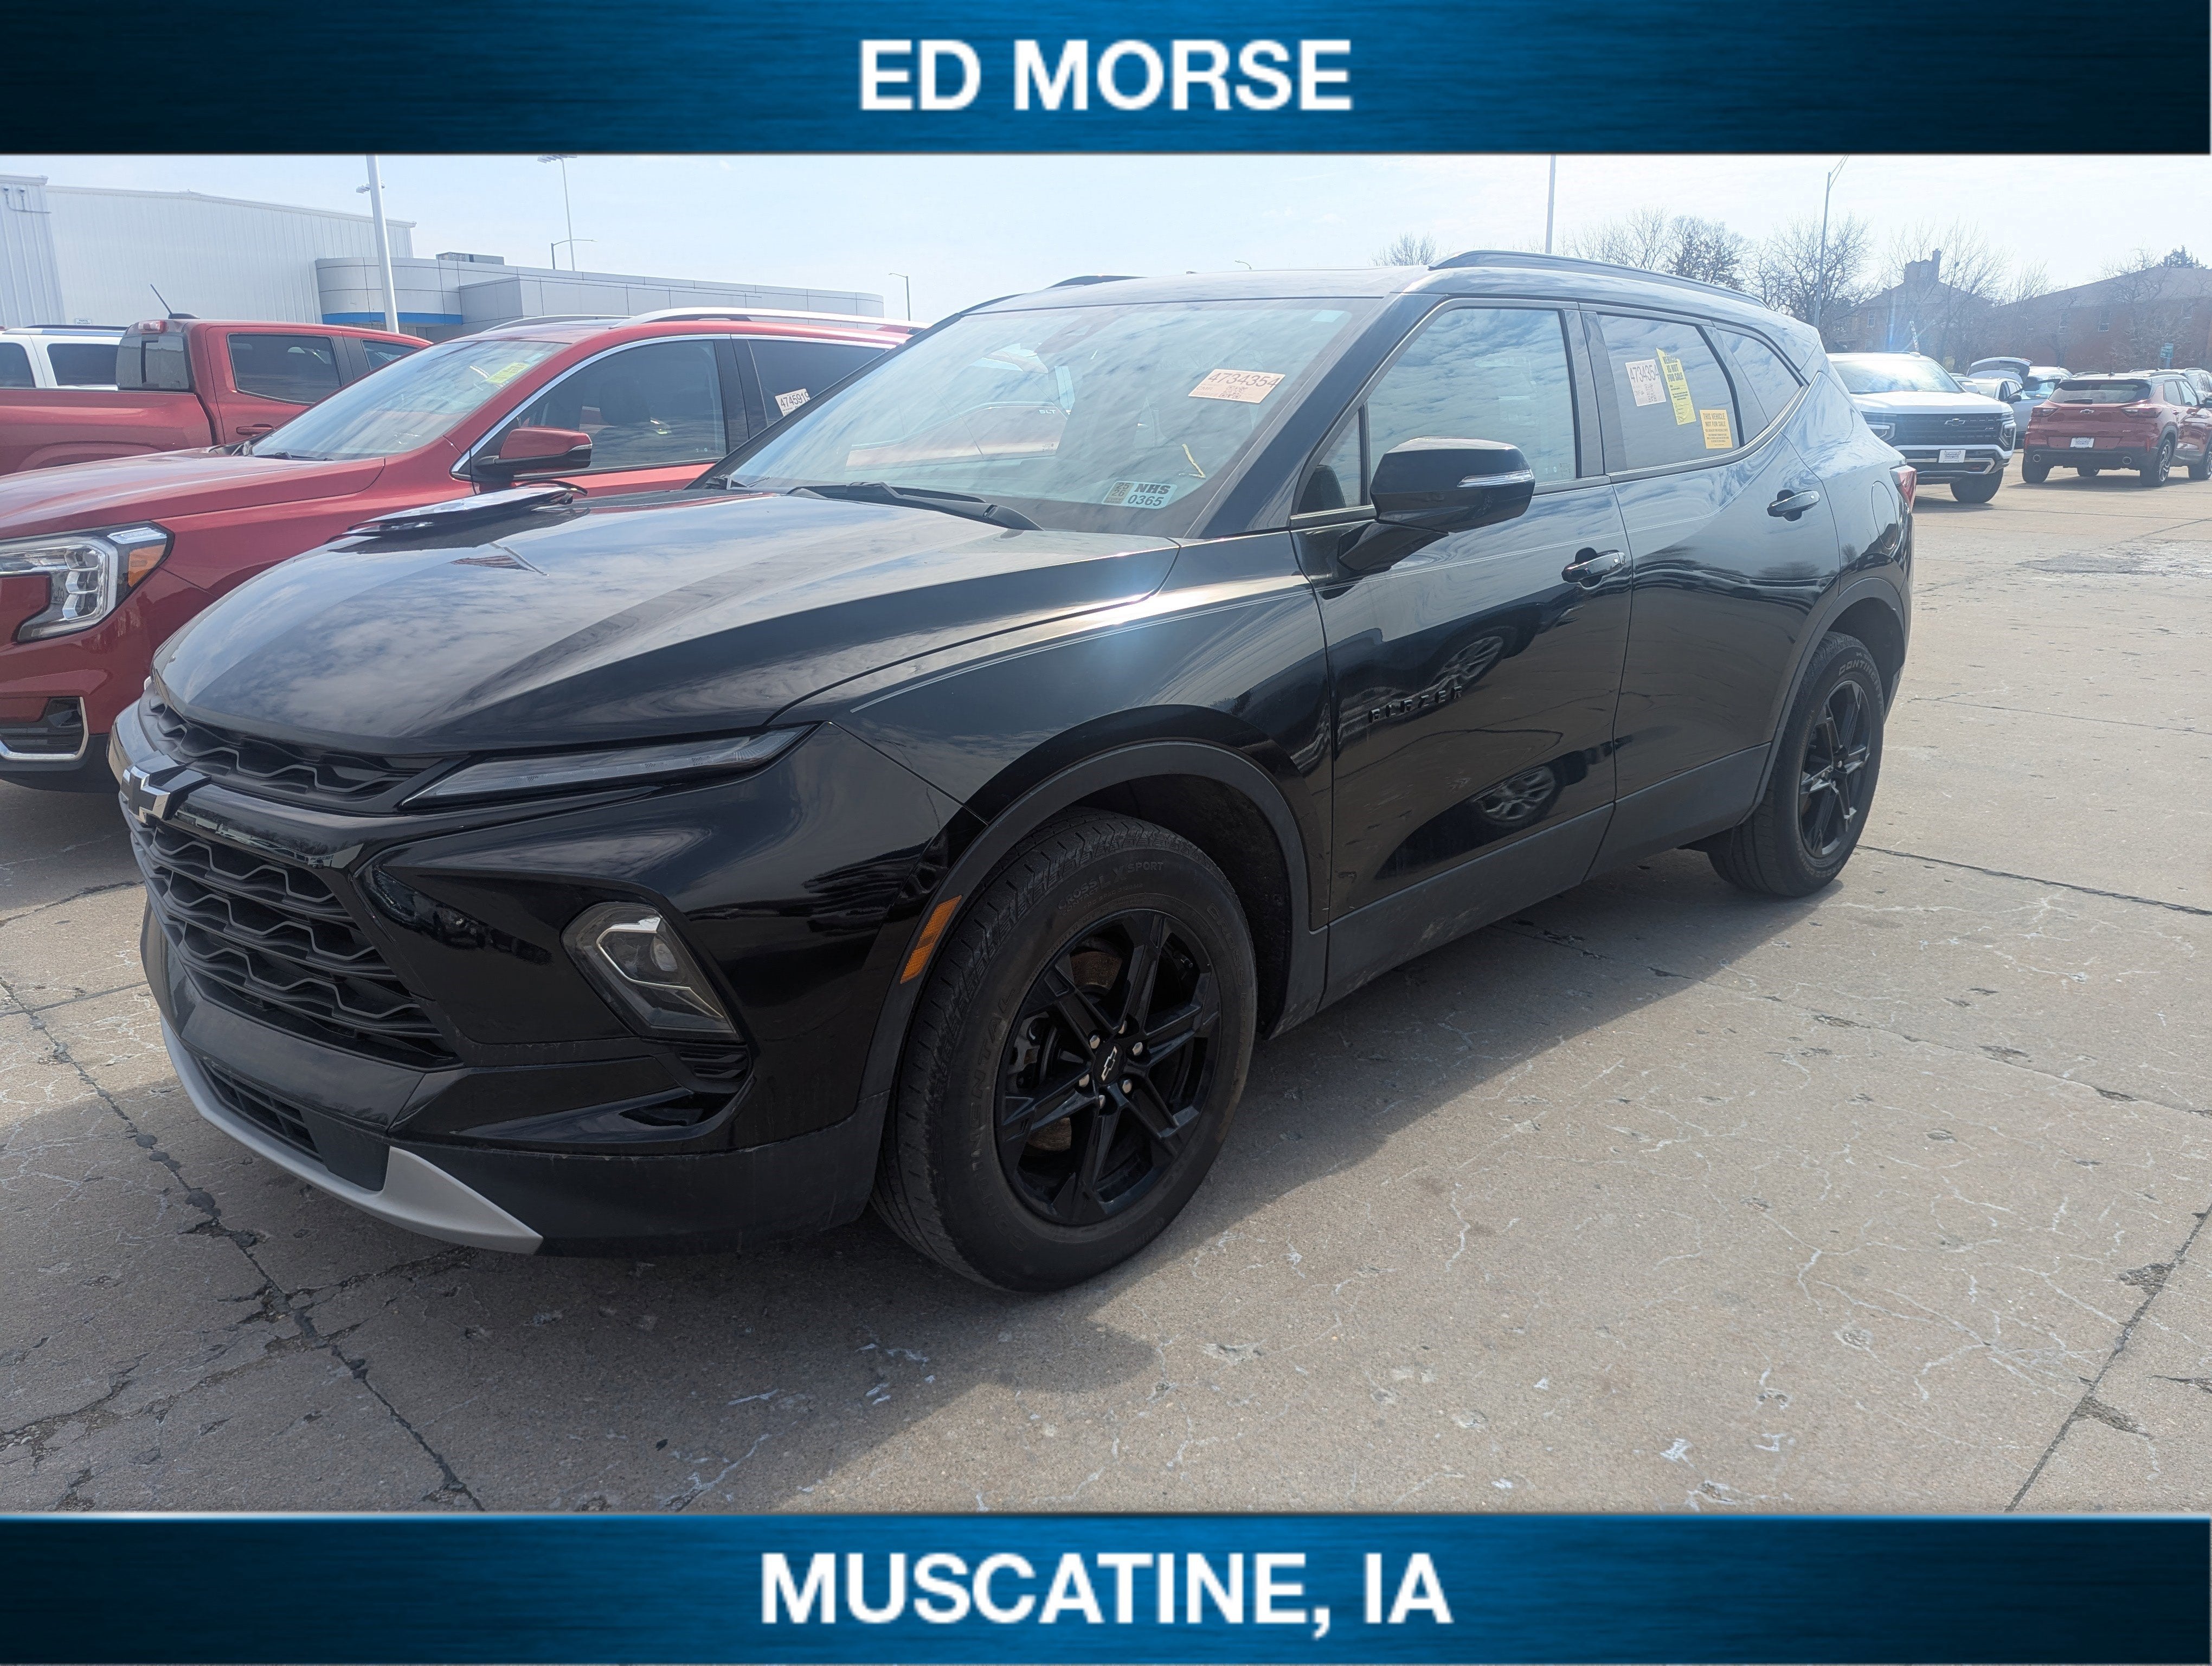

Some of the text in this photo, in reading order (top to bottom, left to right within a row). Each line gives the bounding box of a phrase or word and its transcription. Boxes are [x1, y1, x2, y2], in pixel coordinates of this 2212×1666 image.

[1208, 372, 1281, 388] 4734354
[1630, 364, 1660, 383] 4734354
[781, 391, 809, 408] 4745919
[1134, 483, 1171, 495] NHS
[1127, 494, 1165, 507] 0365
[1058, 878, 1098, 910] CROSS
[1127, 861, 1163, 873] SPORT
